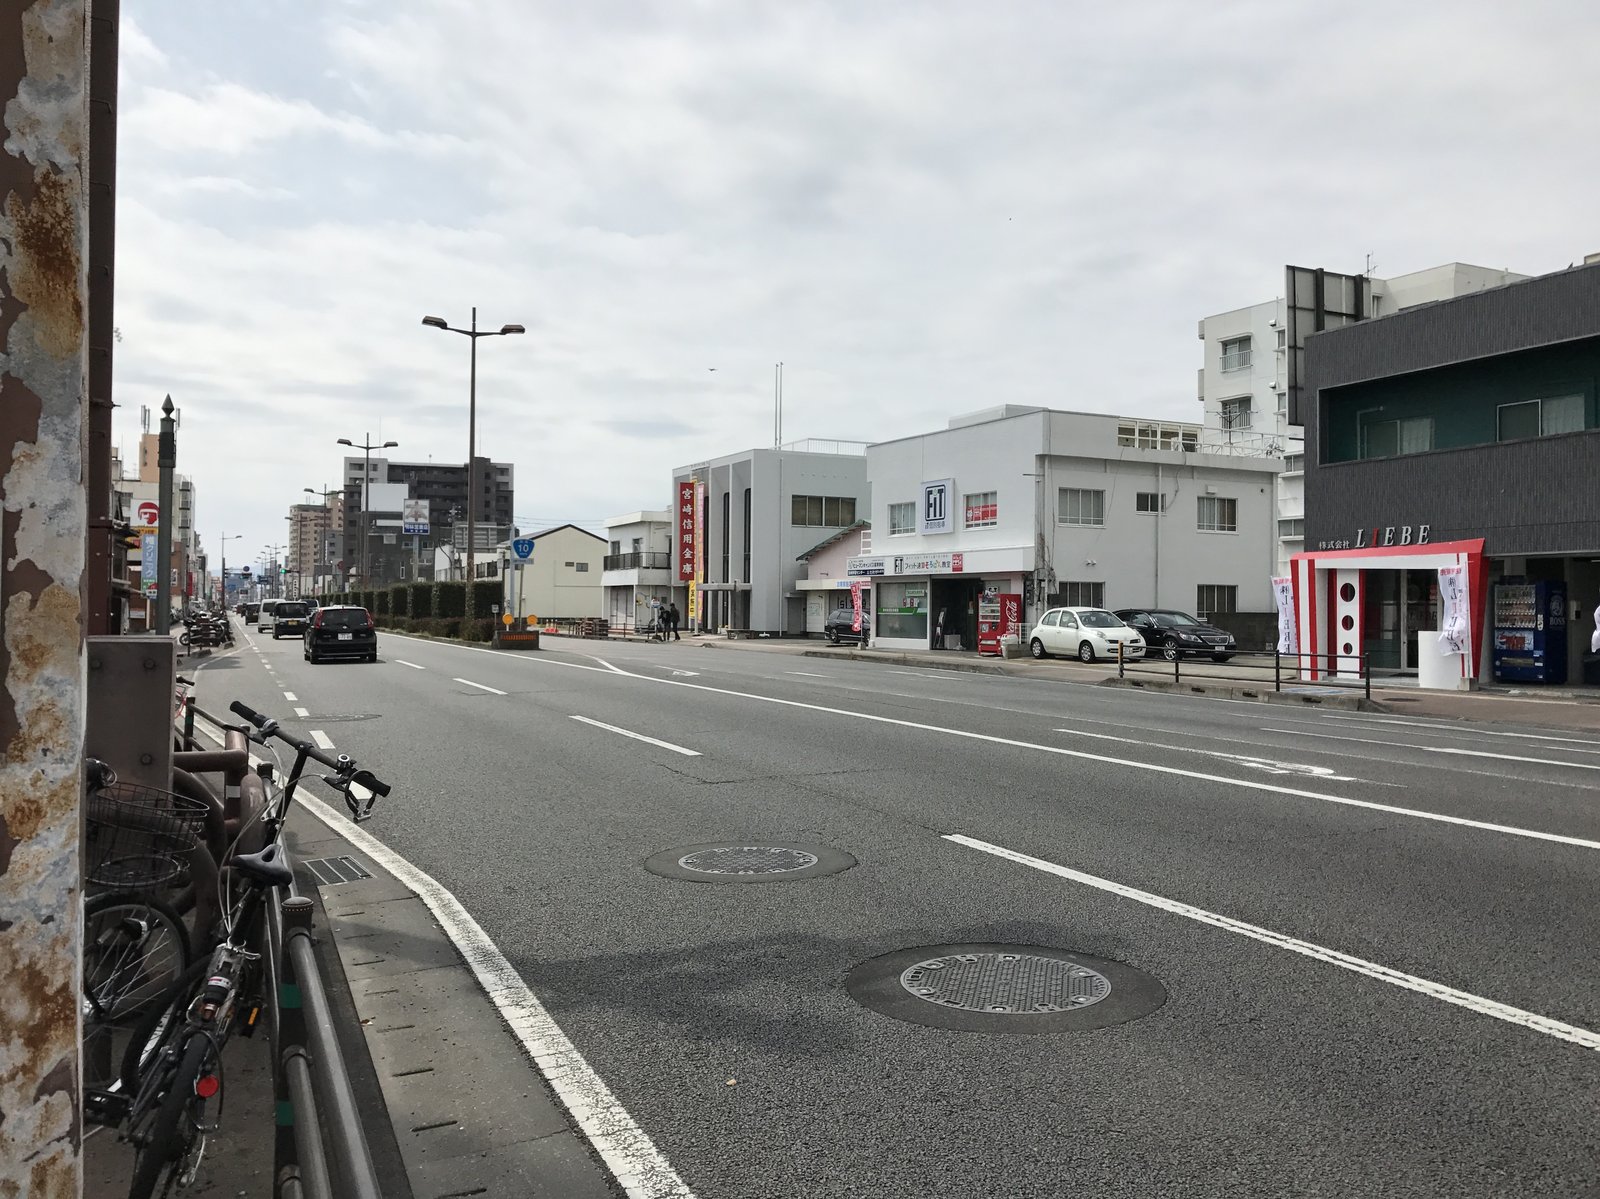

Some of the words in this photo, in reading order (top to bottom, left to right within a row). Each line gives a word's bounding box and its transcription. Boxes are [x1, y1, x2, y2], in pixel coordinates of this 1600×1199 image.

[681, 487, 694, 575] 宮崎信用金庫
[1319, 540, 1350, 549] 株式会社
[1355, 524, 1430, 548] LIEBE
[518, 544, 529, 552] 10
